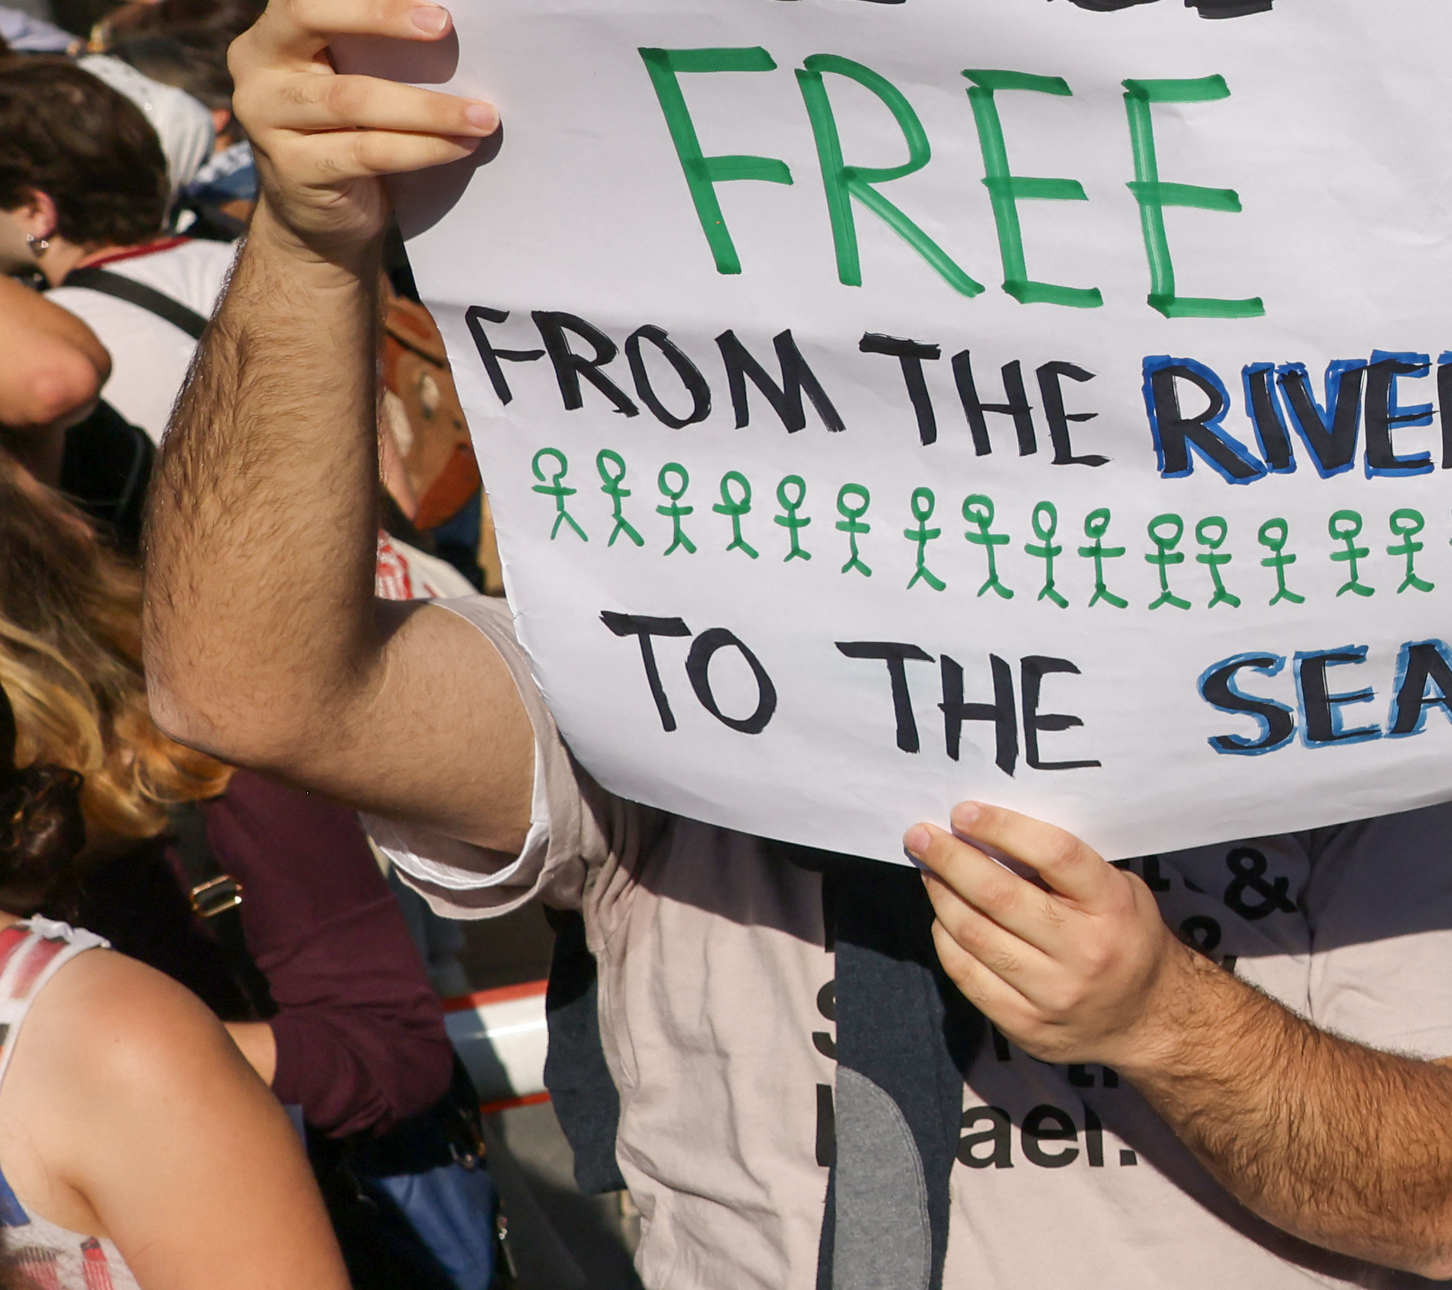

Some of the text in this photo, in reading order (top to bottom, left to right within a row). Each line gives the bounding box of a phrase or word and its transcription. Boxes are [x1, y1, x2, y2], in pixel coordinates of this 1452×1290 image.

[640, 46, 1266, 320] FREE
[468, 305, 844, 435] FROM
[859, 330, 1113, 468] THE
[599, 611, 779, 736] TO
[834, 639, 1103, 779] THE
